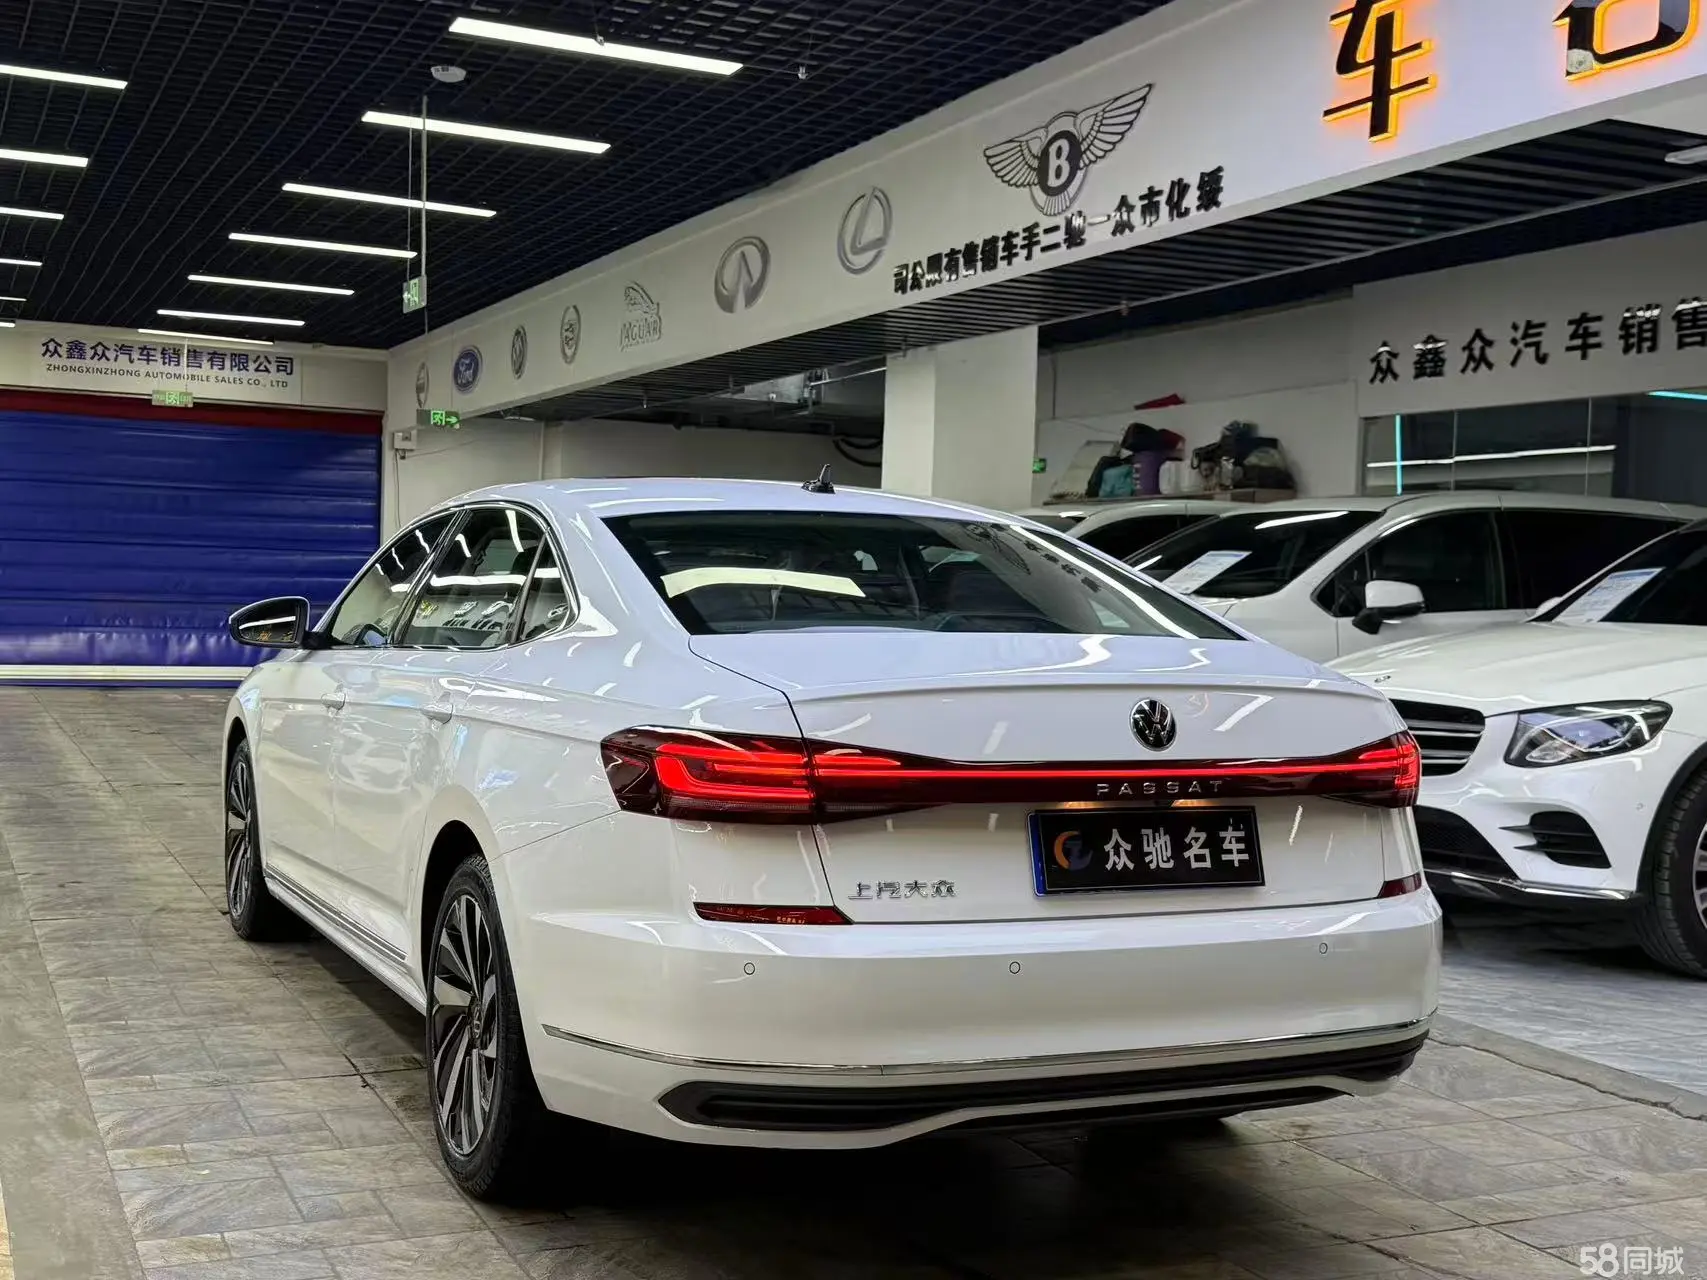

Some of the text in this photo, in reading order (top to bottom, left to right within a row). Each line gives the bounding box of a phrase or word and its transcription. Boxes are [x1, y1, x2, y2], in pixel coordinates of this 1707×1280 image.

[41, 338, 294, 376] 众鑫众汽车销售有限公司
[46, 363, 141, 378] ZHONGXINZHONG
[144, 370, 211, 383] AUTOMOBILE
[214, 375, 244, 386] SALES
[270, 380, 288, 389] LTD
[1096, 780, 1223, 796] PASSAT
[1104, 825, 1249, 871] 众驰名车
[848, 880, 955, 900] 上汽大众
